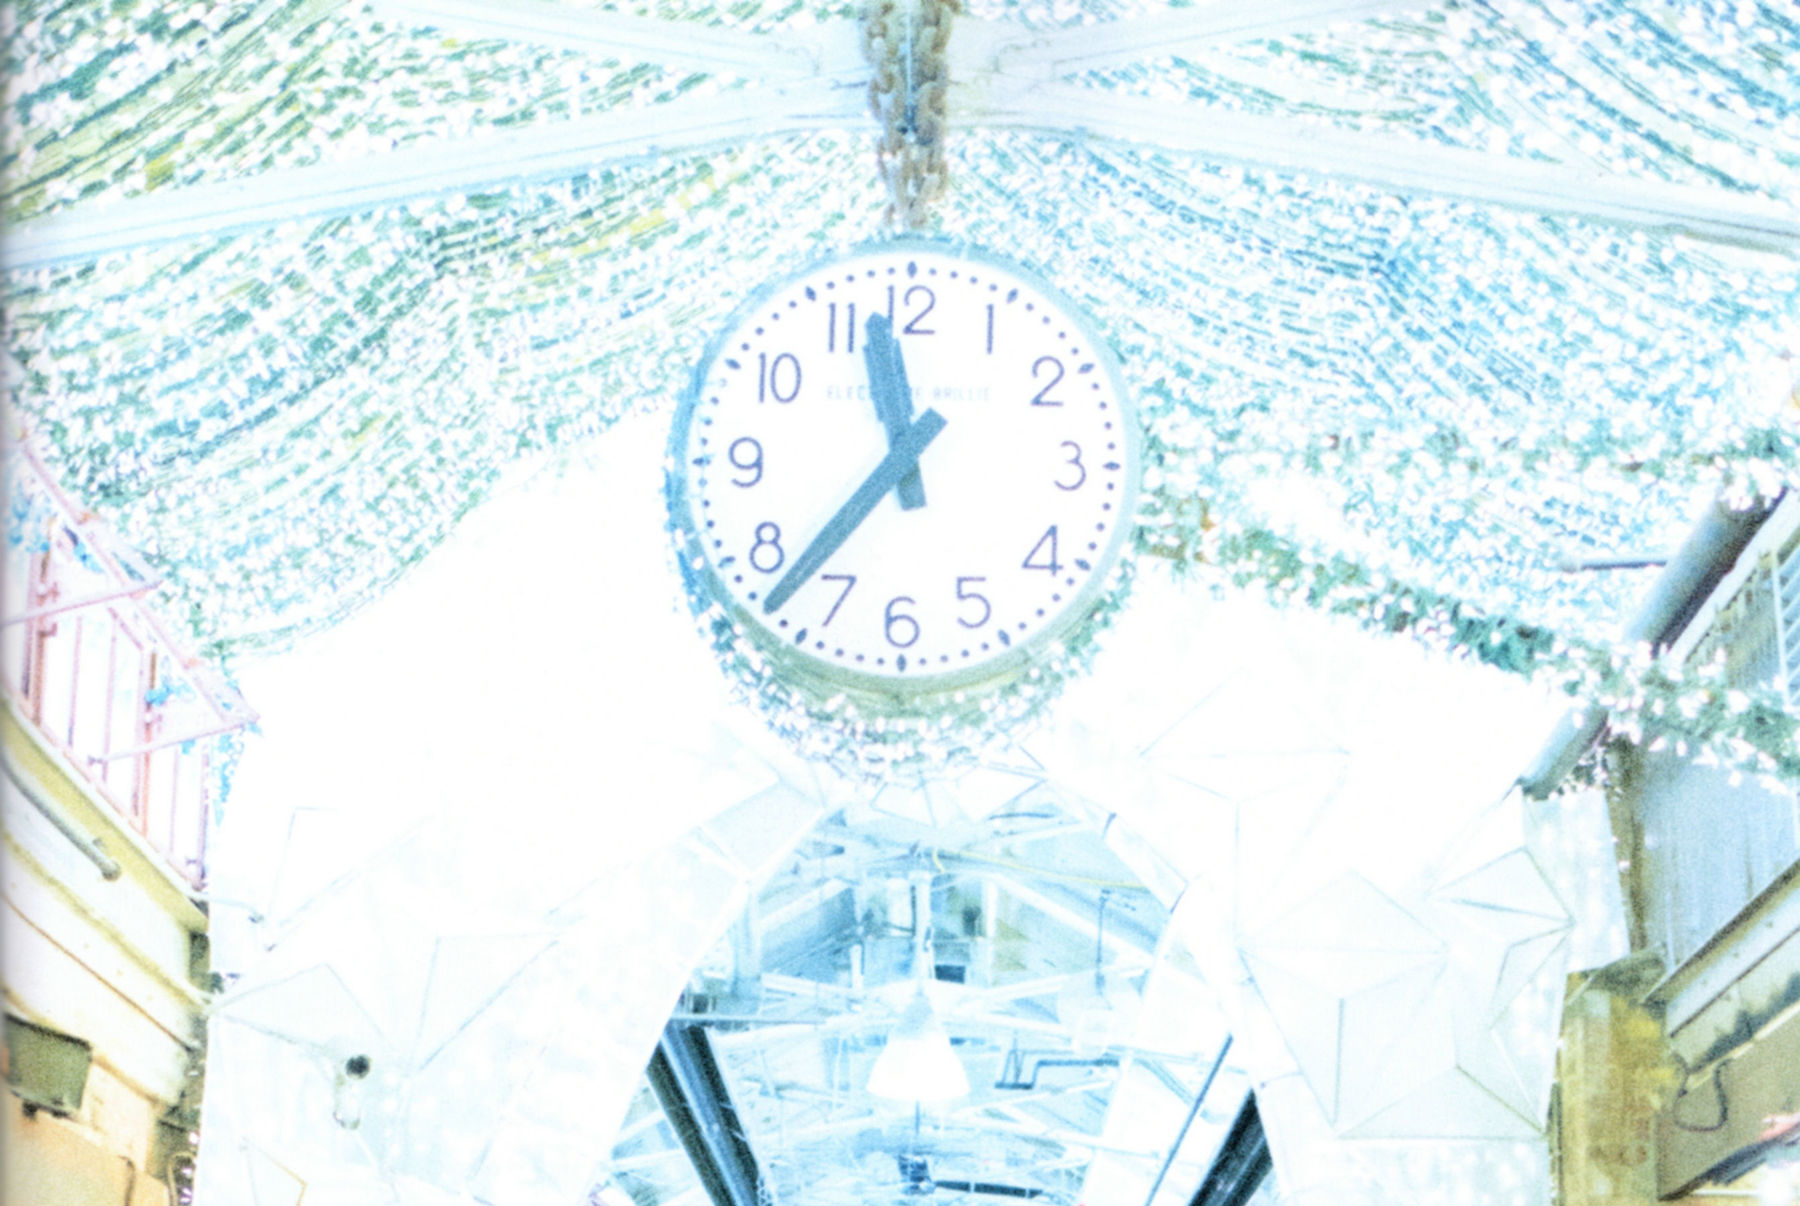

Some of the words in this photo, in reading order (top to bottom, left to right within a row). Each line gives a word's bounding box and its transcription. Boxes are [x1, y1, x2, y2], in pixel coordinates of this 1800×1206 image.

[829, 303, 856, 353] 11
[885, 285, 936, 336] 12
[986, 304, 995, 355] 1
[758, 352, 802, 403] 10
[1030, 356, 1065, 407] 2
[728, 437, 764, 488] 9
[1053, 440, 1087, 491] 3
[749, 521, 785, 574] 8
[1022, 525, 1064, 577] 4
[821, 574, 858, 628] 7
[884, 596, 921, 649] 6
[956, 577, 992, 629] 5
